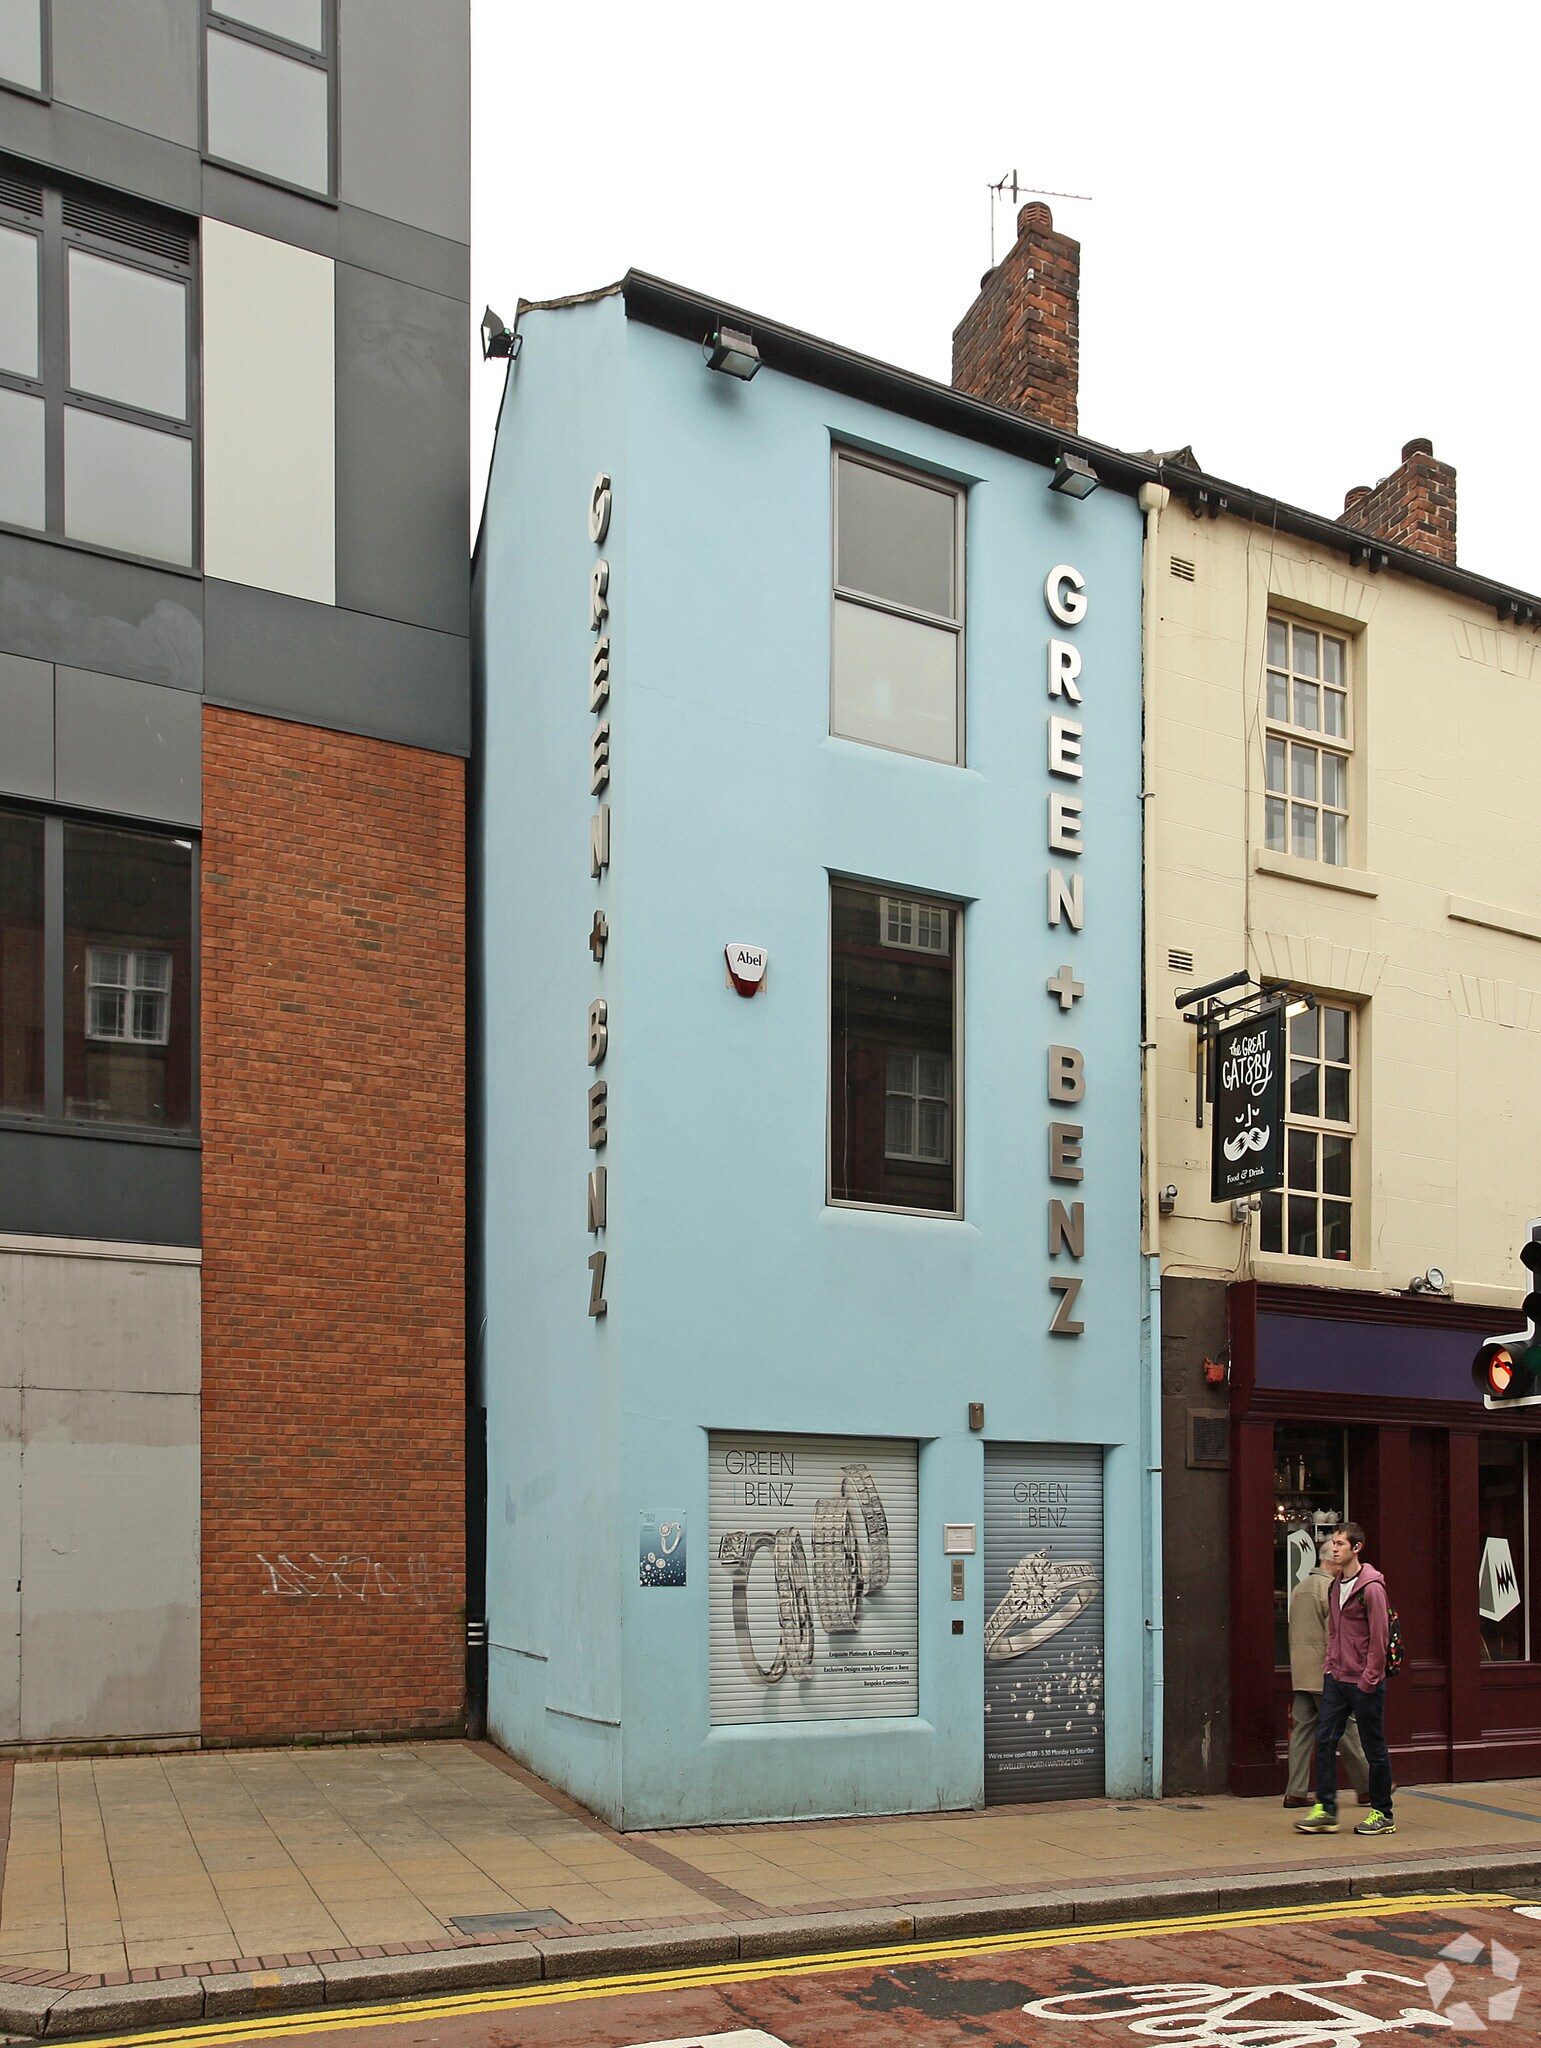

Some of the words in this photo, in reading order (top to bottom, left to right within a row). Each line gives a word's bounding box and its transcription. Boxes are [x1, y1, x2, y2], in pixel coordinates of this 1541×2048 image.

[588, 472, 612, 879] GREEN
[1043, 563, 1088, 932] GREEN
[736, 950, 762, 967] Abel
[1047, 964, 1085, 1010] +
[1228, 1037, 1242, 1056] the
[1242, 1030, 1268, 1056] GREAT
[1222, 1049, 1273, 1097] GATSBY
[587, 999, 608, 1318] BENZ
[1226, 1172, 1240, 1184] Food
[1240, 1169, 1248, 1180] &
[1248, 1165, 1265, 1178] Drink
[1048, 1043, 1086, 1335] BENZ
[725, 1450, 794, 1475] GREEN
[744, 1482, 794, 1506] BENZ
[1013, 1482, 1068, 1503] GREEN
[1029, 1507, 1068, 1528] BENZ
